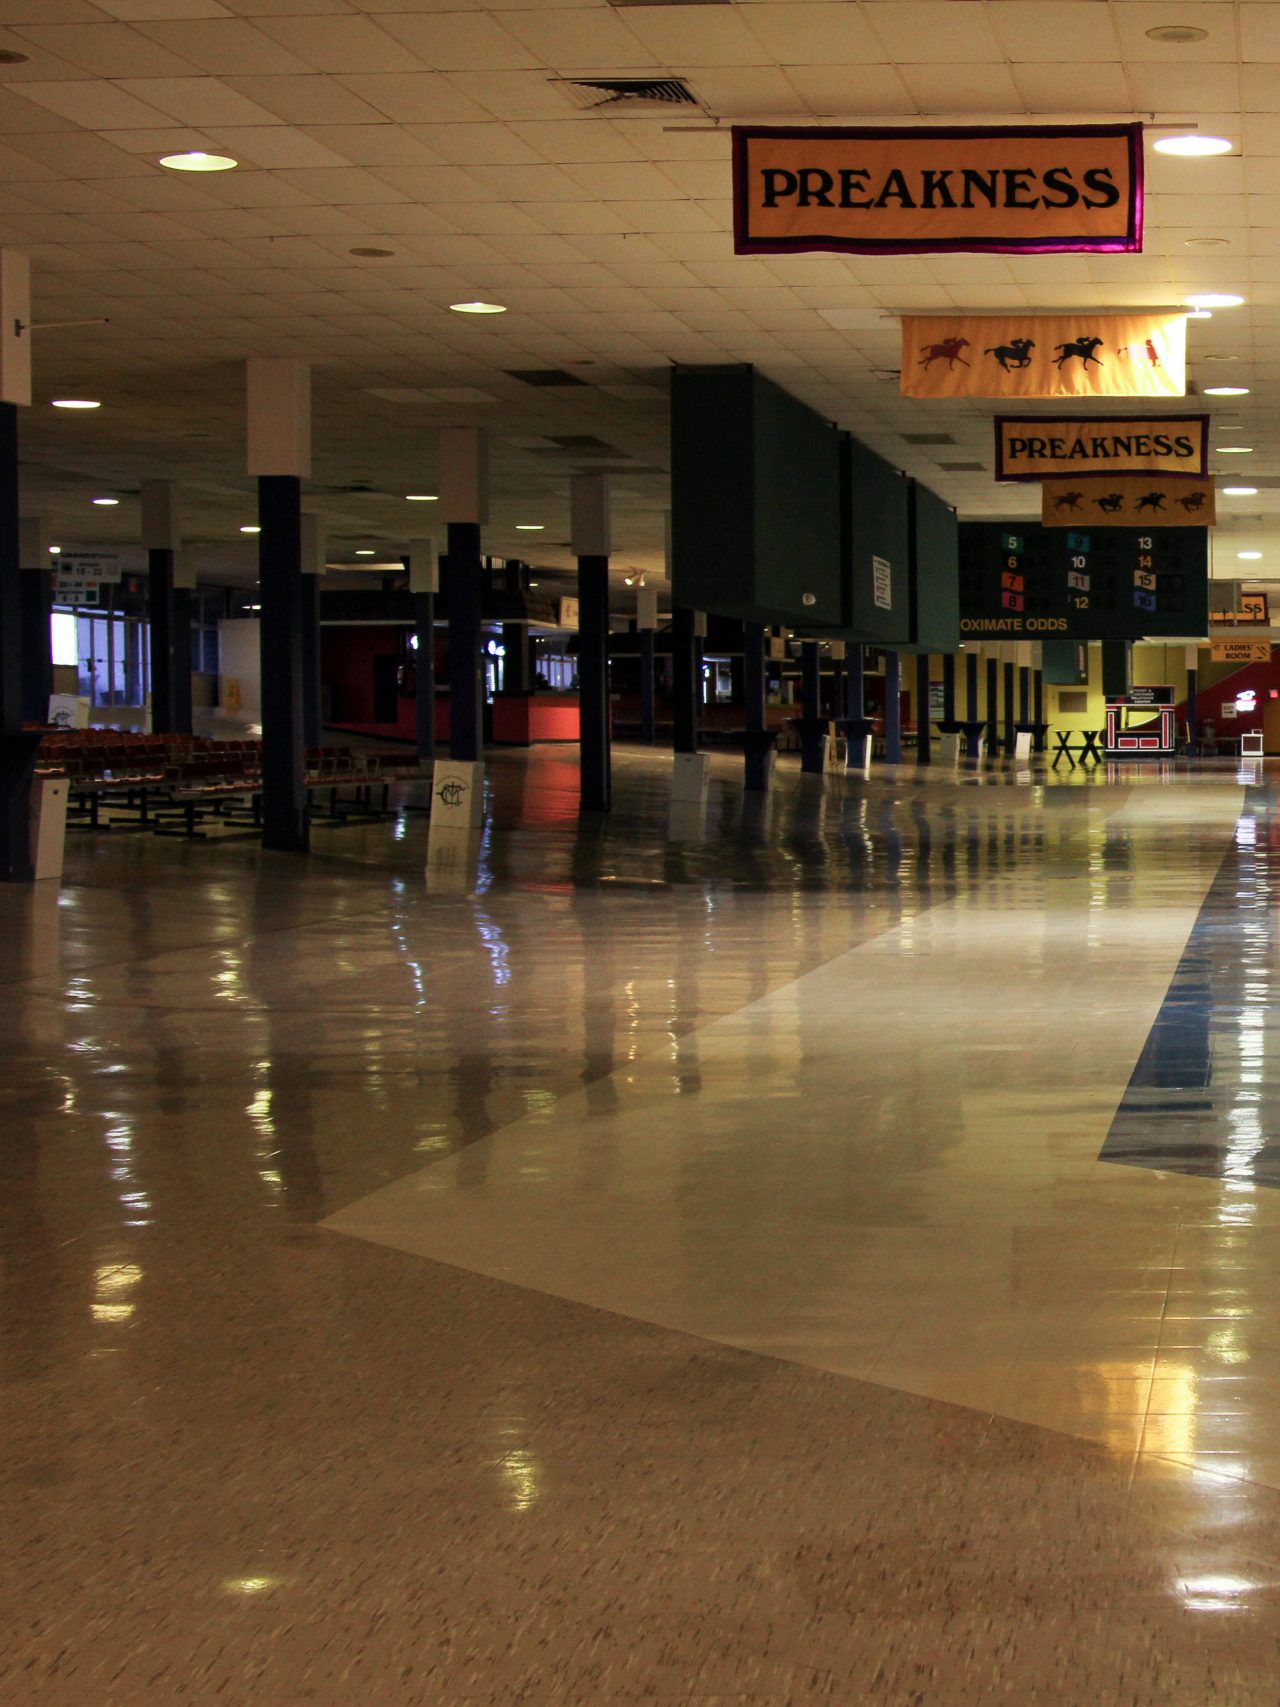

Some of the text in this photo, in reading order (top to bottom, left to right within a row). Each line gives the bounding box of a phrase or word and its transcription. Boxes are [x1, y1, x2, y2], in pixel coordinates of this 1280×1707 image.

[761, 167, 1120, 210] PREAKNESS
[1008, 434, 1194, 459] PREAKNESS
[1007, 537, 1017, 549] 5
[1075, 537, 1083, 549] 9
[1138, 537, 1153, 549] 13
[1007, 556, 1017, 568] 6
[1072, 556, 1086, 568] 10
[1138, 556, 1152, 568] 14
[1007, 576, 1017, 587] 7
[1073, 576, 1085, 587] 11
[1138, 574, 1151, 586] 15
[1008, 595, 1017, 607] 8
[1074, 597, 1089, 608] 12
[1138, 595, 1151, 606] 16
[960, 618, 1068, 631] OXIMATE ODDS
